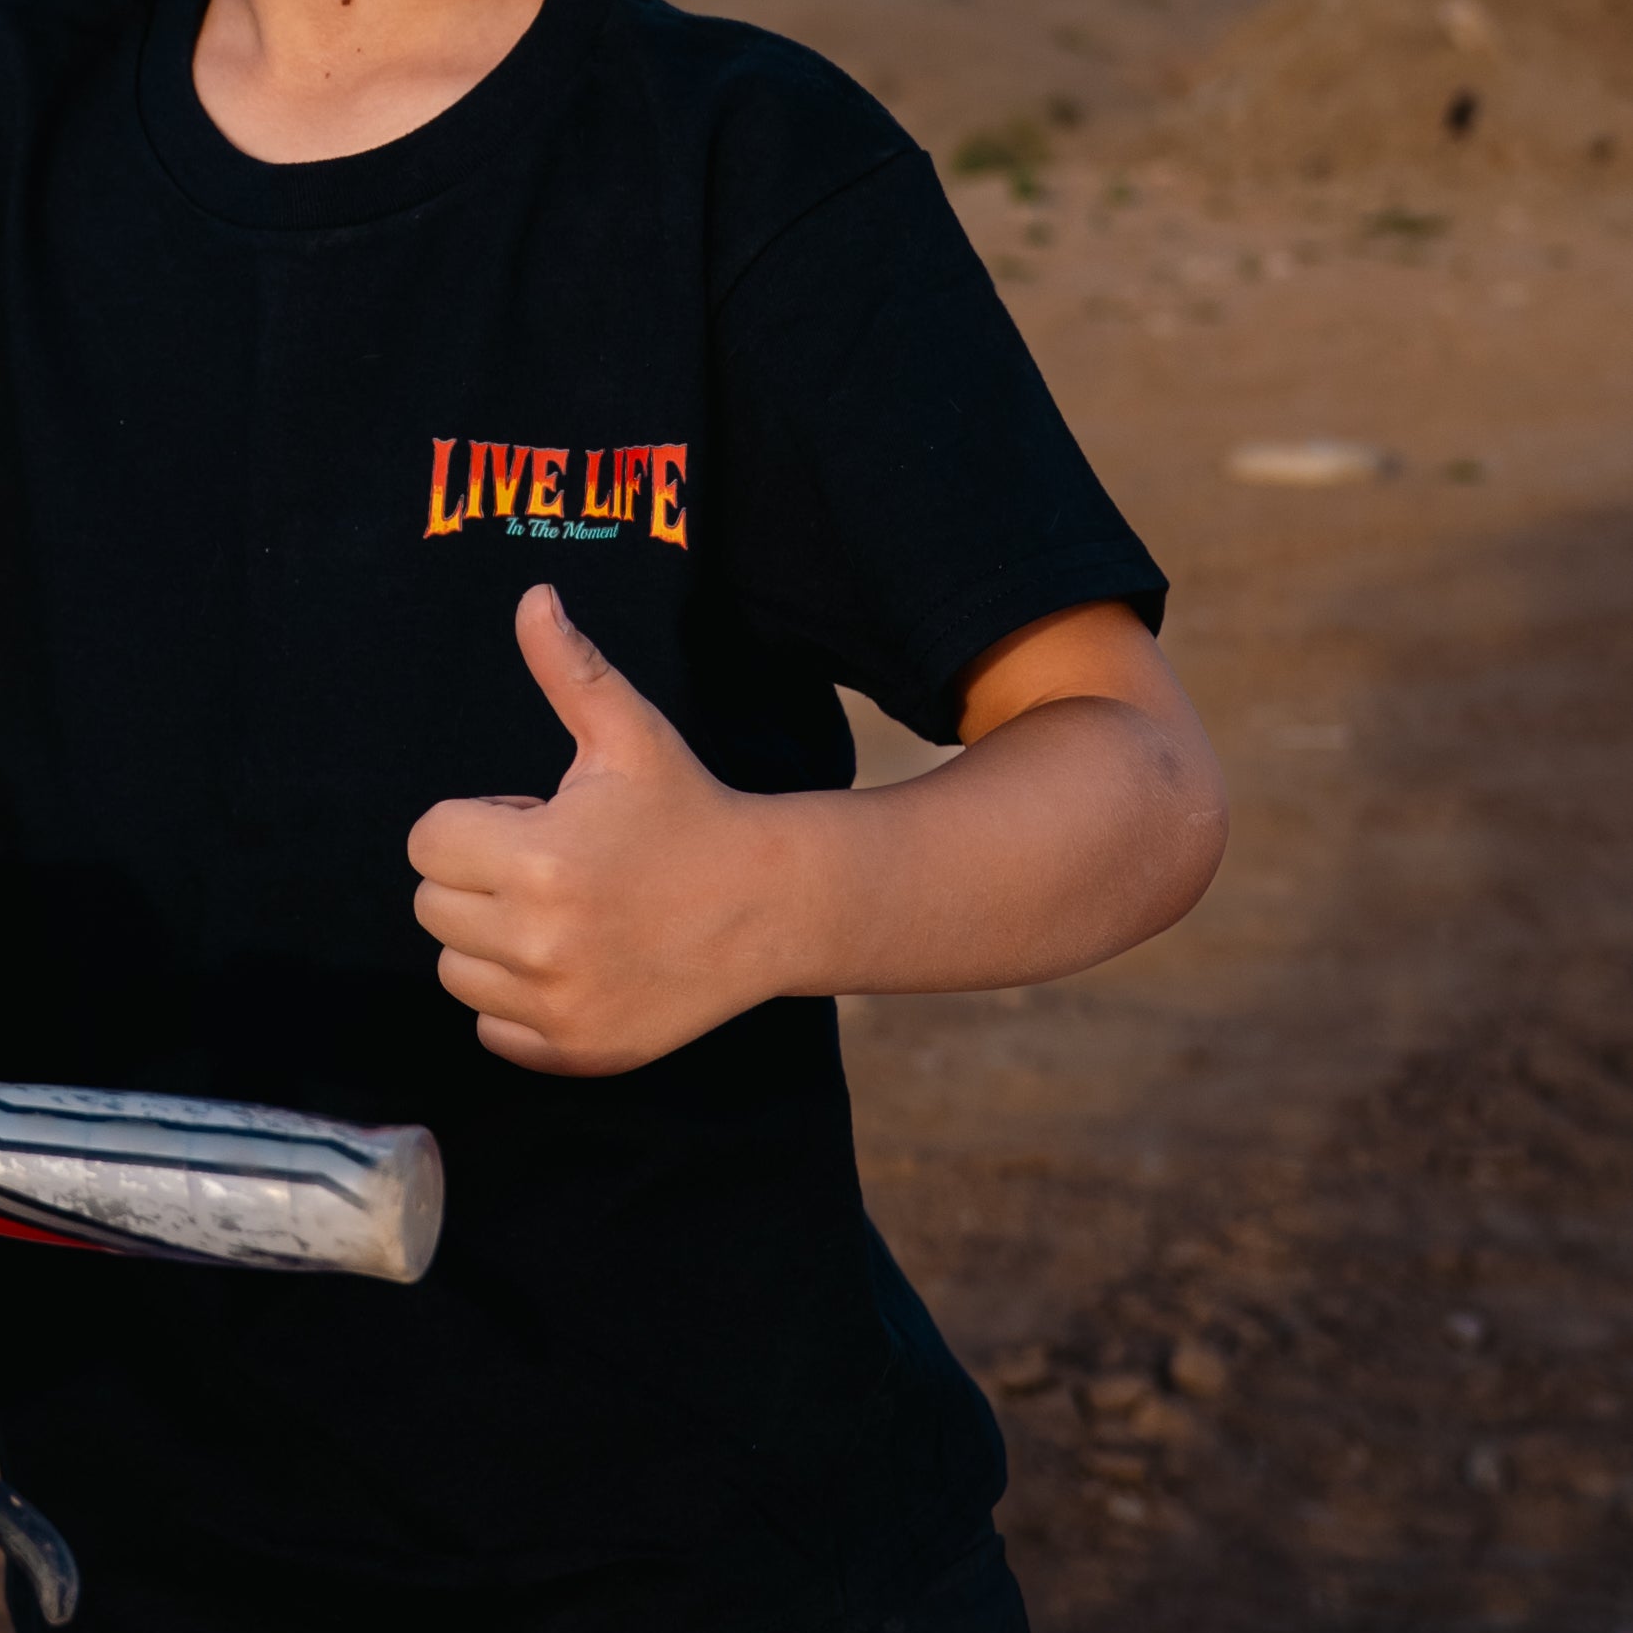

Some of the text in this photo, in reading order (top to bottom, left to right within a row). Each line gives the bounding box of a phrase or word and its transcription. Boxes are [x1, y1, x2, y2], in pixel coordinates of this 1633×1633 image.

[423, 437, 689, 551] LIVE LIFE
[505, 517, 619, 540] In The Moment
